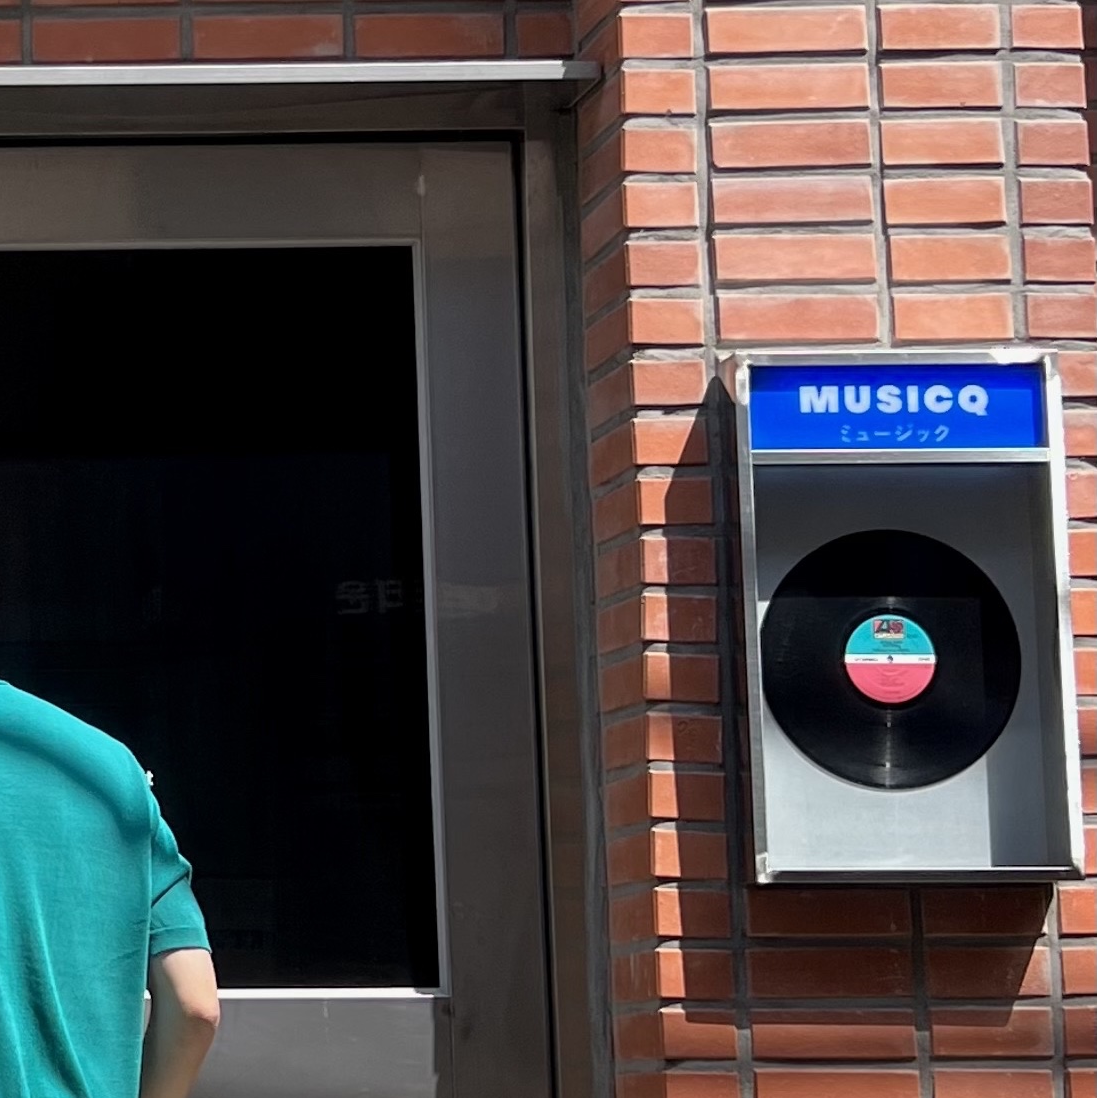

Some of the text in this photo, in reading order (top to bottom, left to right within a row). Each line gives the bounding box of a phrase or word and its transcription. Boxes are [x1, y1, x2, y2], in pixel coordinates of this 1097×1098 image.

[799, 384, 989, 416] MUSICQ
[840, 424, 949, 442] ミュージック
